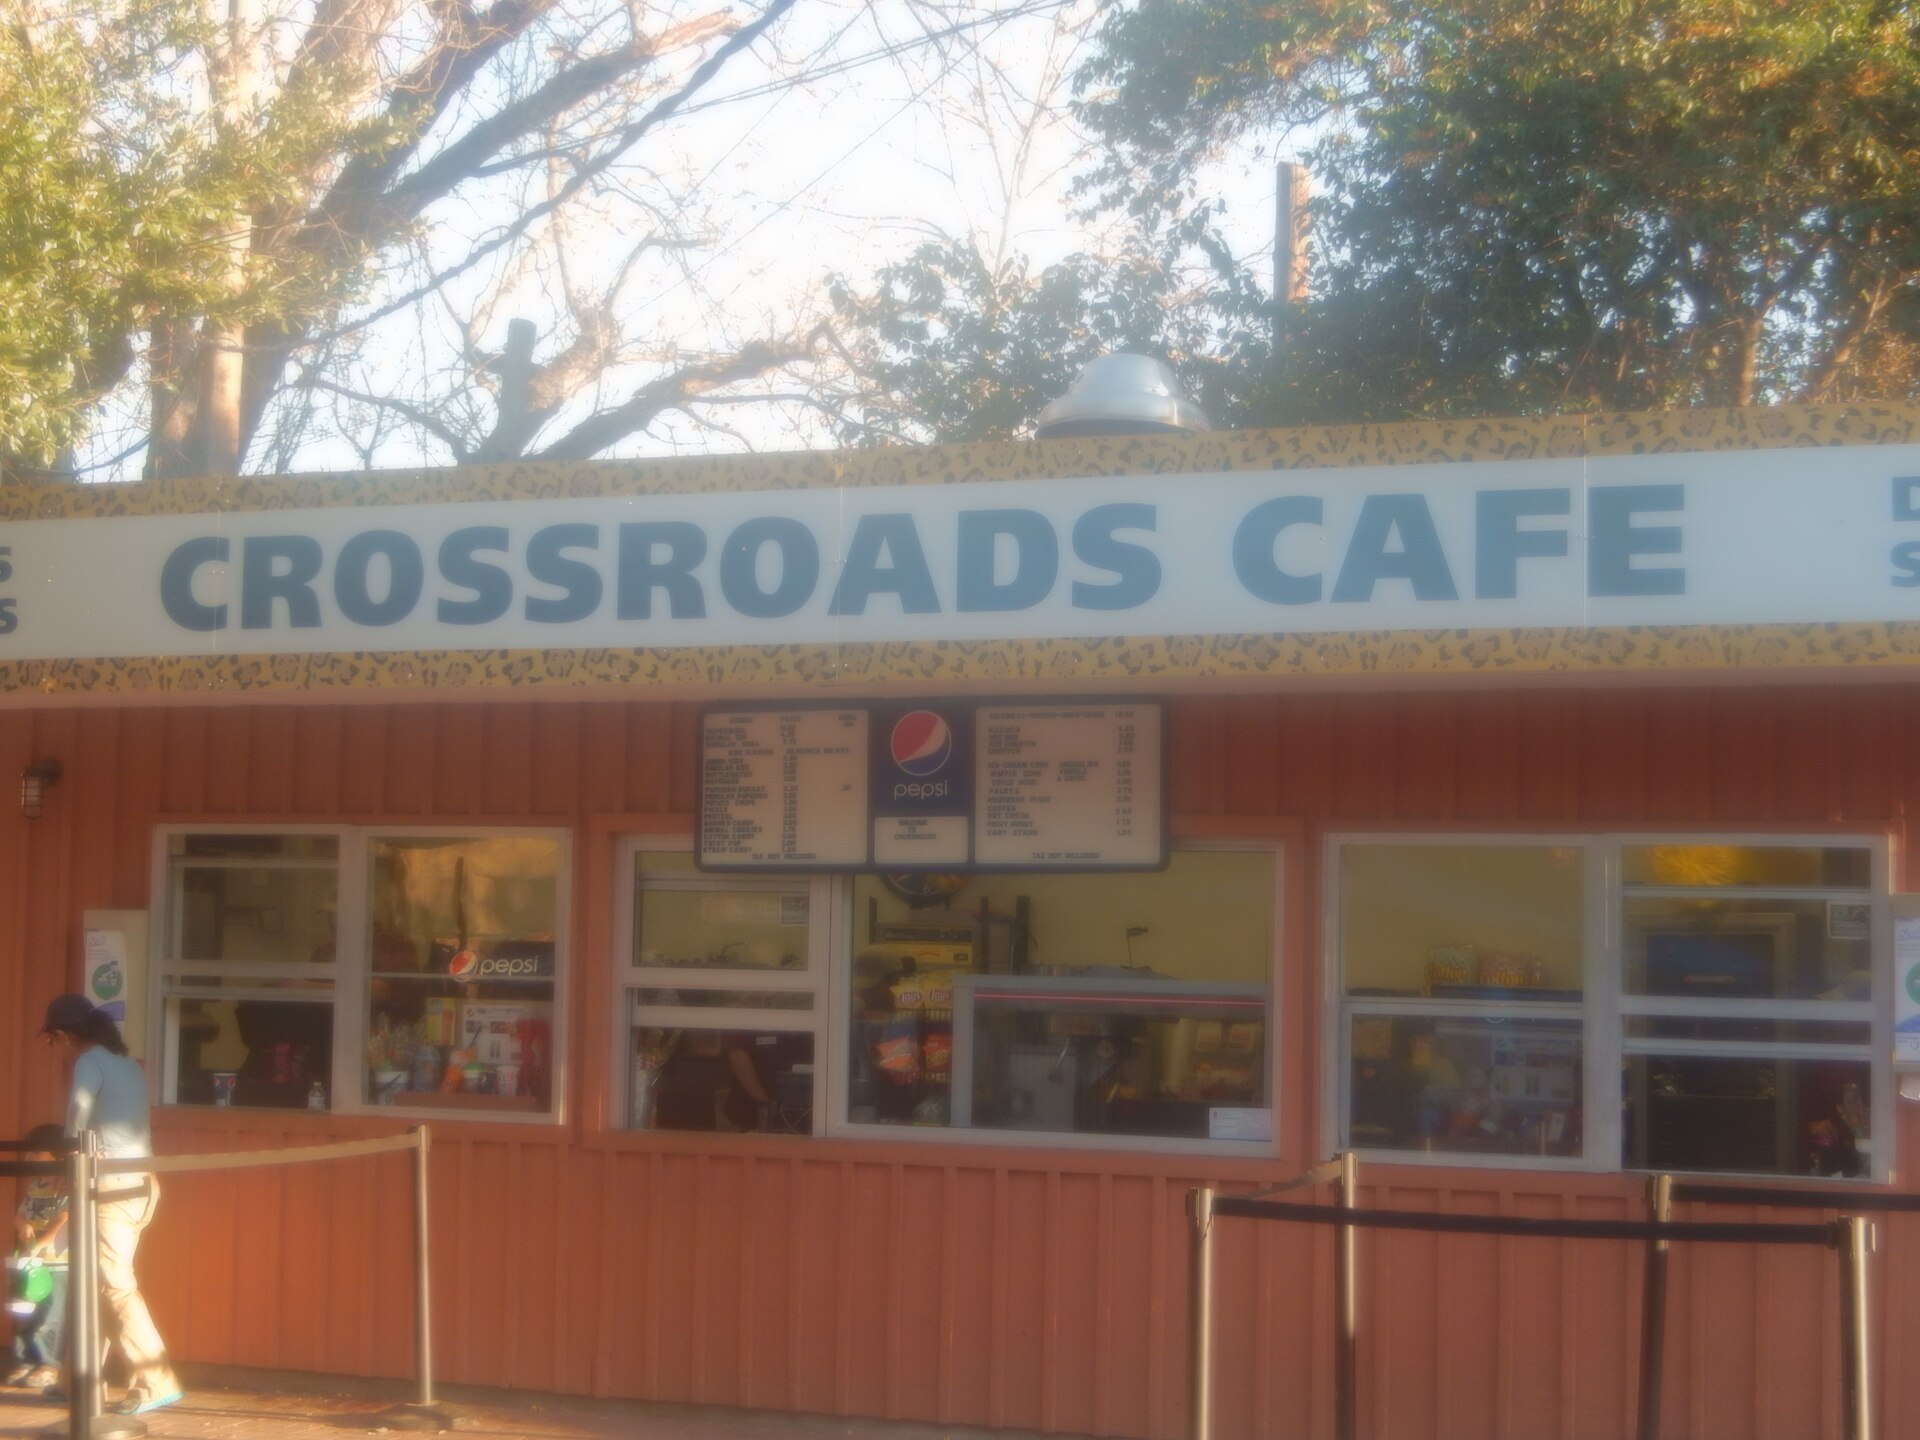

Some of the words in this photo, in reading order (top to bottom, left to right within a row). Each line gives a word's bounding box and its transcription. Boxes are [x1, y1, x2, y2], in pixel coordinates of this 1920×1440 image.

[160, 502, 1159, 632] CROSSROADS
[1232, 484, 1687, 606] CAFE
[894, 780, 949, 800] pepsi
[480, 955, 539, 976] pepsi
